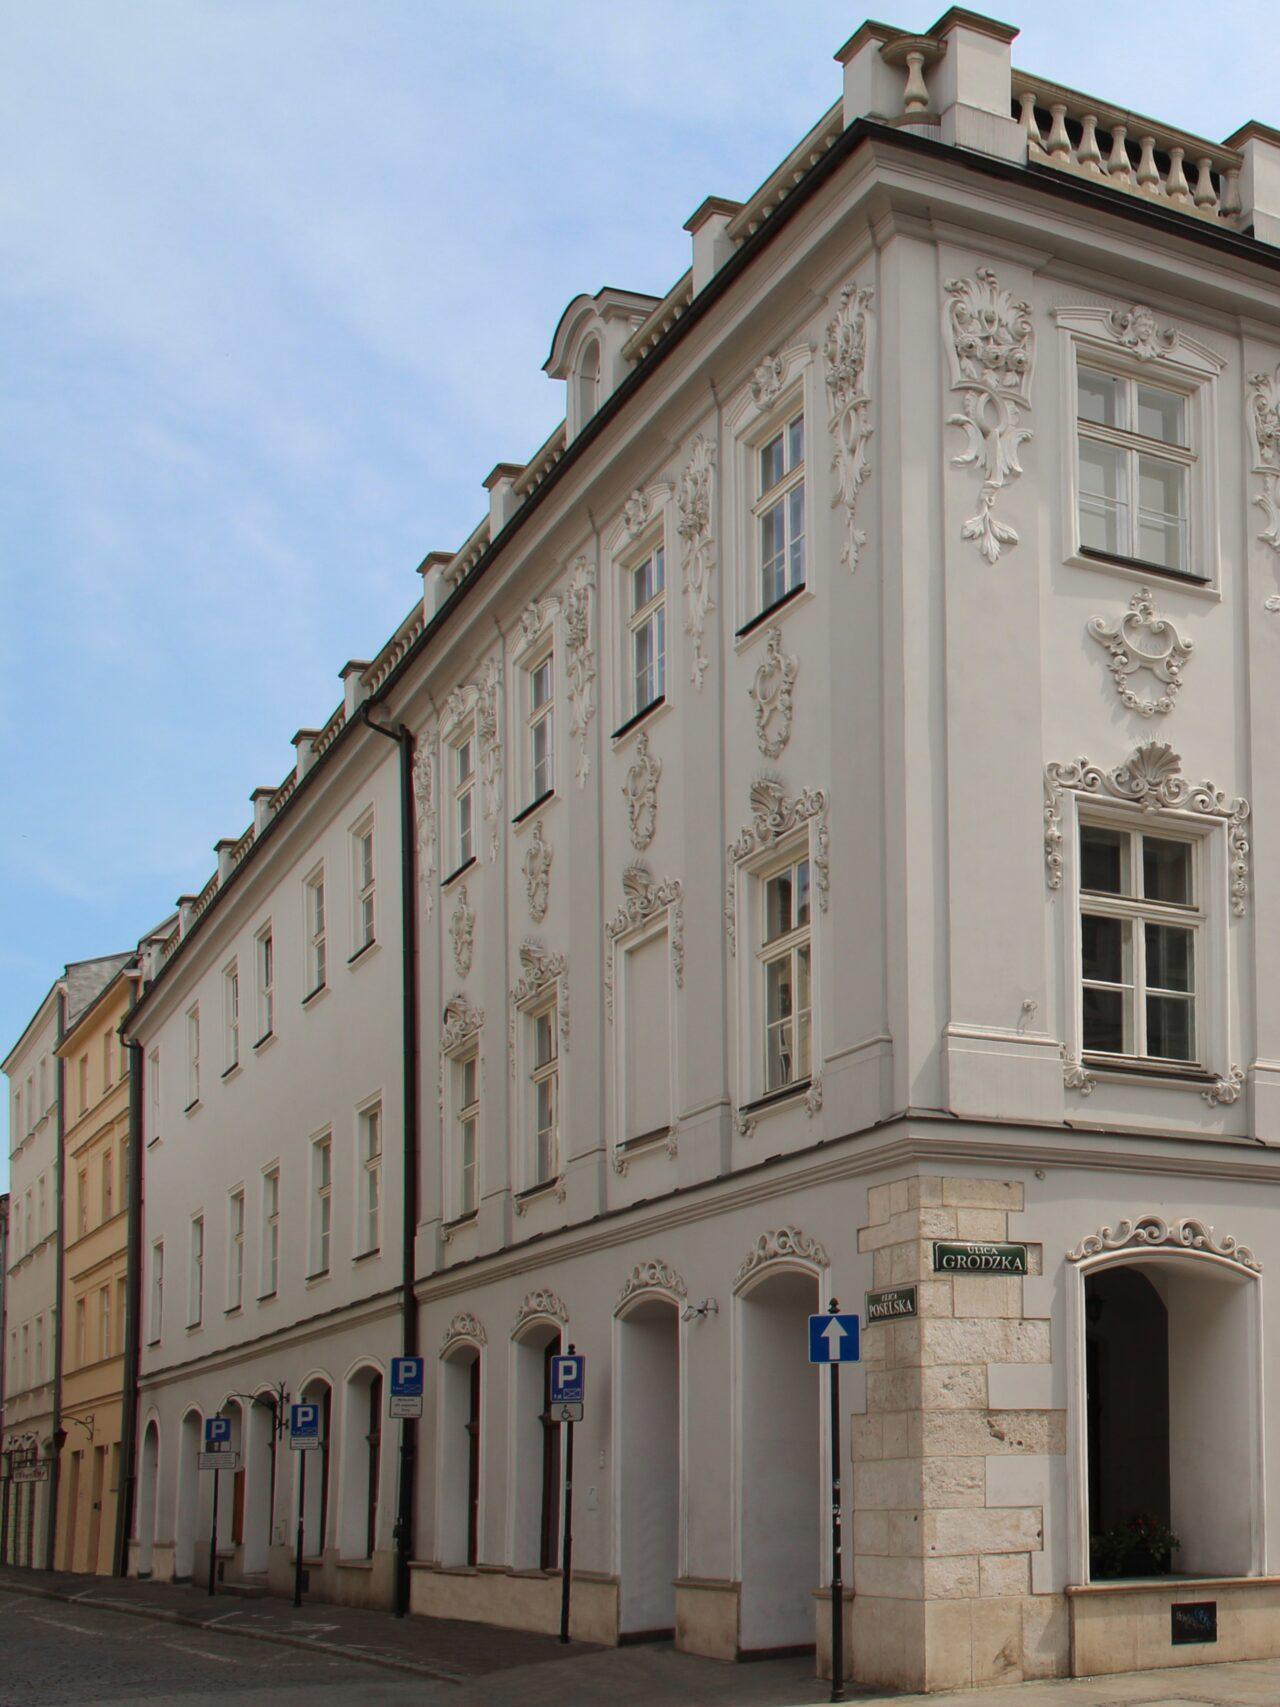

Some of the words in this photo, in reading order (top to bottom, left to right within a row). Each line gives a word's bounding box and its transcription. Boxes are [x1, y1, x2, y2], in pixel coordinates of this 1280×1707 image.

[967, 1247, 998, 1255] ULICA
[943, 1255, 1023, 1270] GRODZKA
[869, 1299, 912, 1318] POSELSKA
[398, 1361, 417, 1384] P
[558, 1360, 577, 1389] P
[297, 1407, 314, 1427] P
[210, 1421, 226, 1439] P
